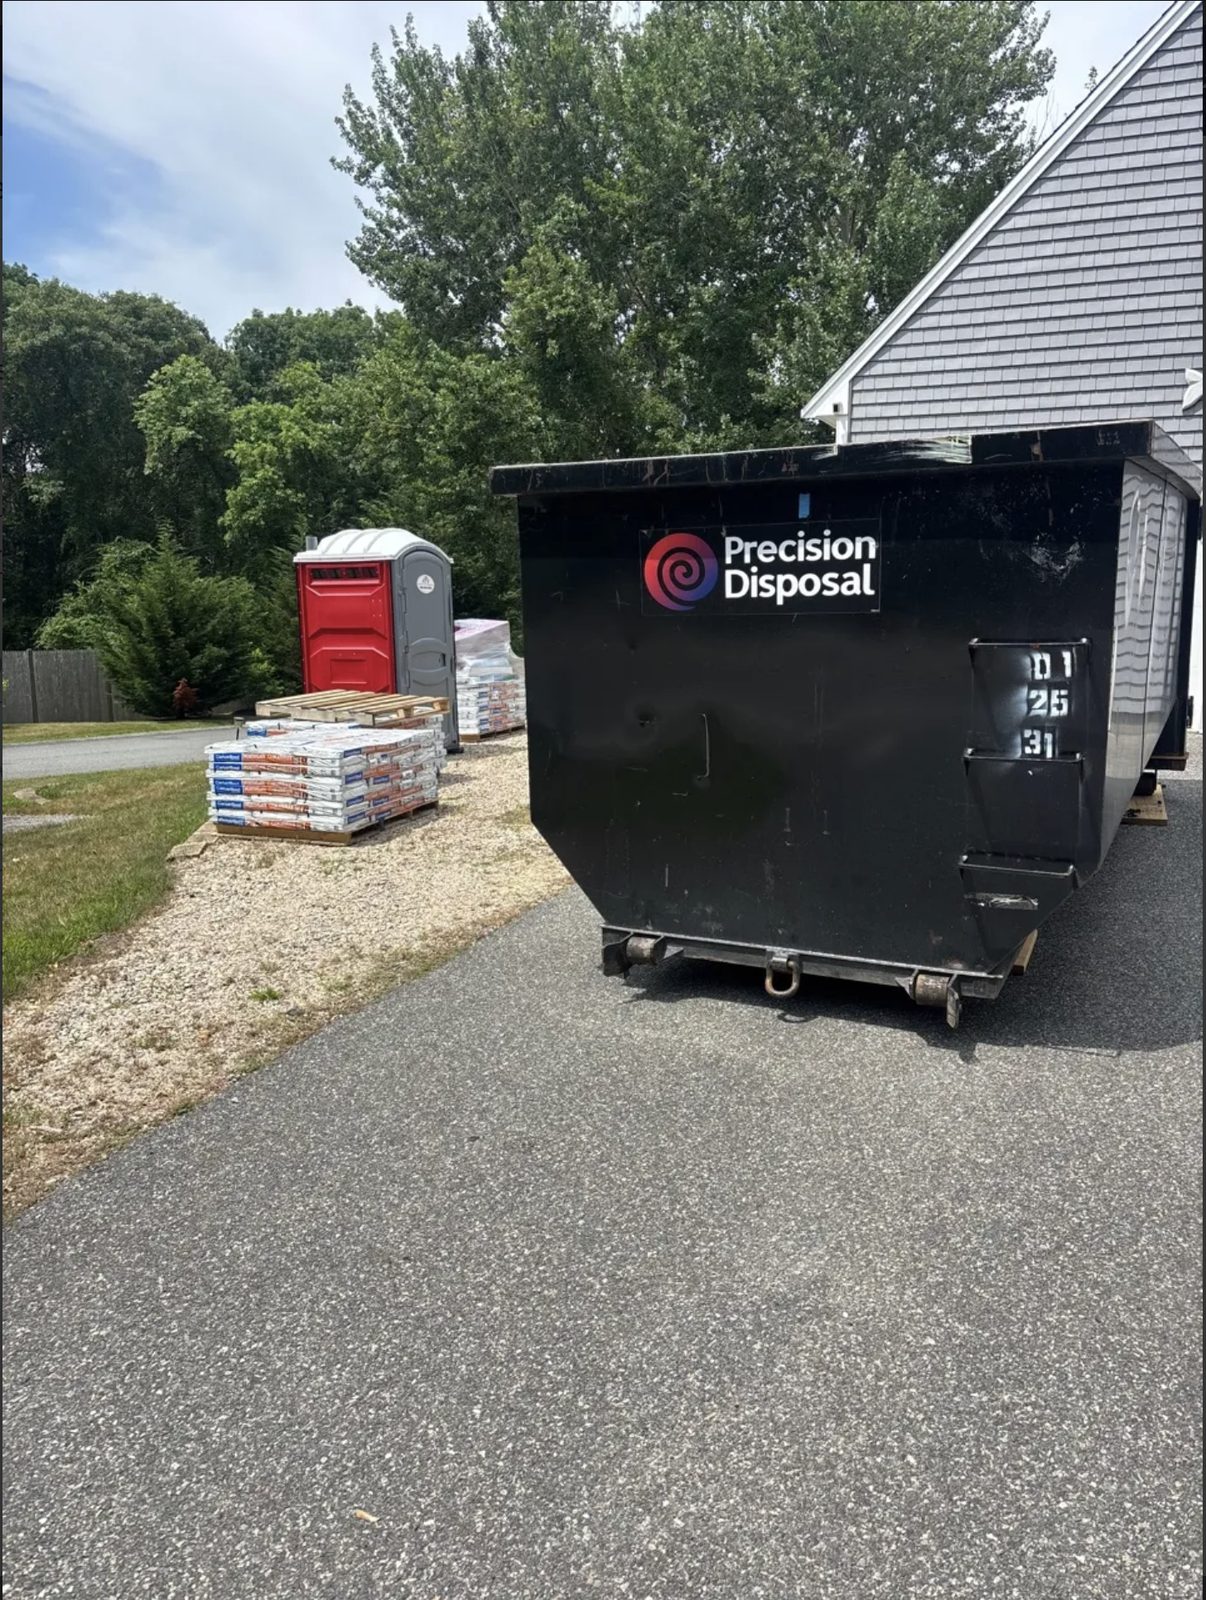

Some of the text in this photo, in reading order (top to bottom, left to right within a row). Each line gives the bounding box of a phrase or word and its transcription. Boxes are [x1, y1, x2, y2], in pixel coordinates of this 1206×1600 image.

[725, 529, 877, 564] Precision
[725, 563, 875, 606] Disposal
[1028, 689, 1069, 717] 25
[1023, 729, 1053, 758] 31
